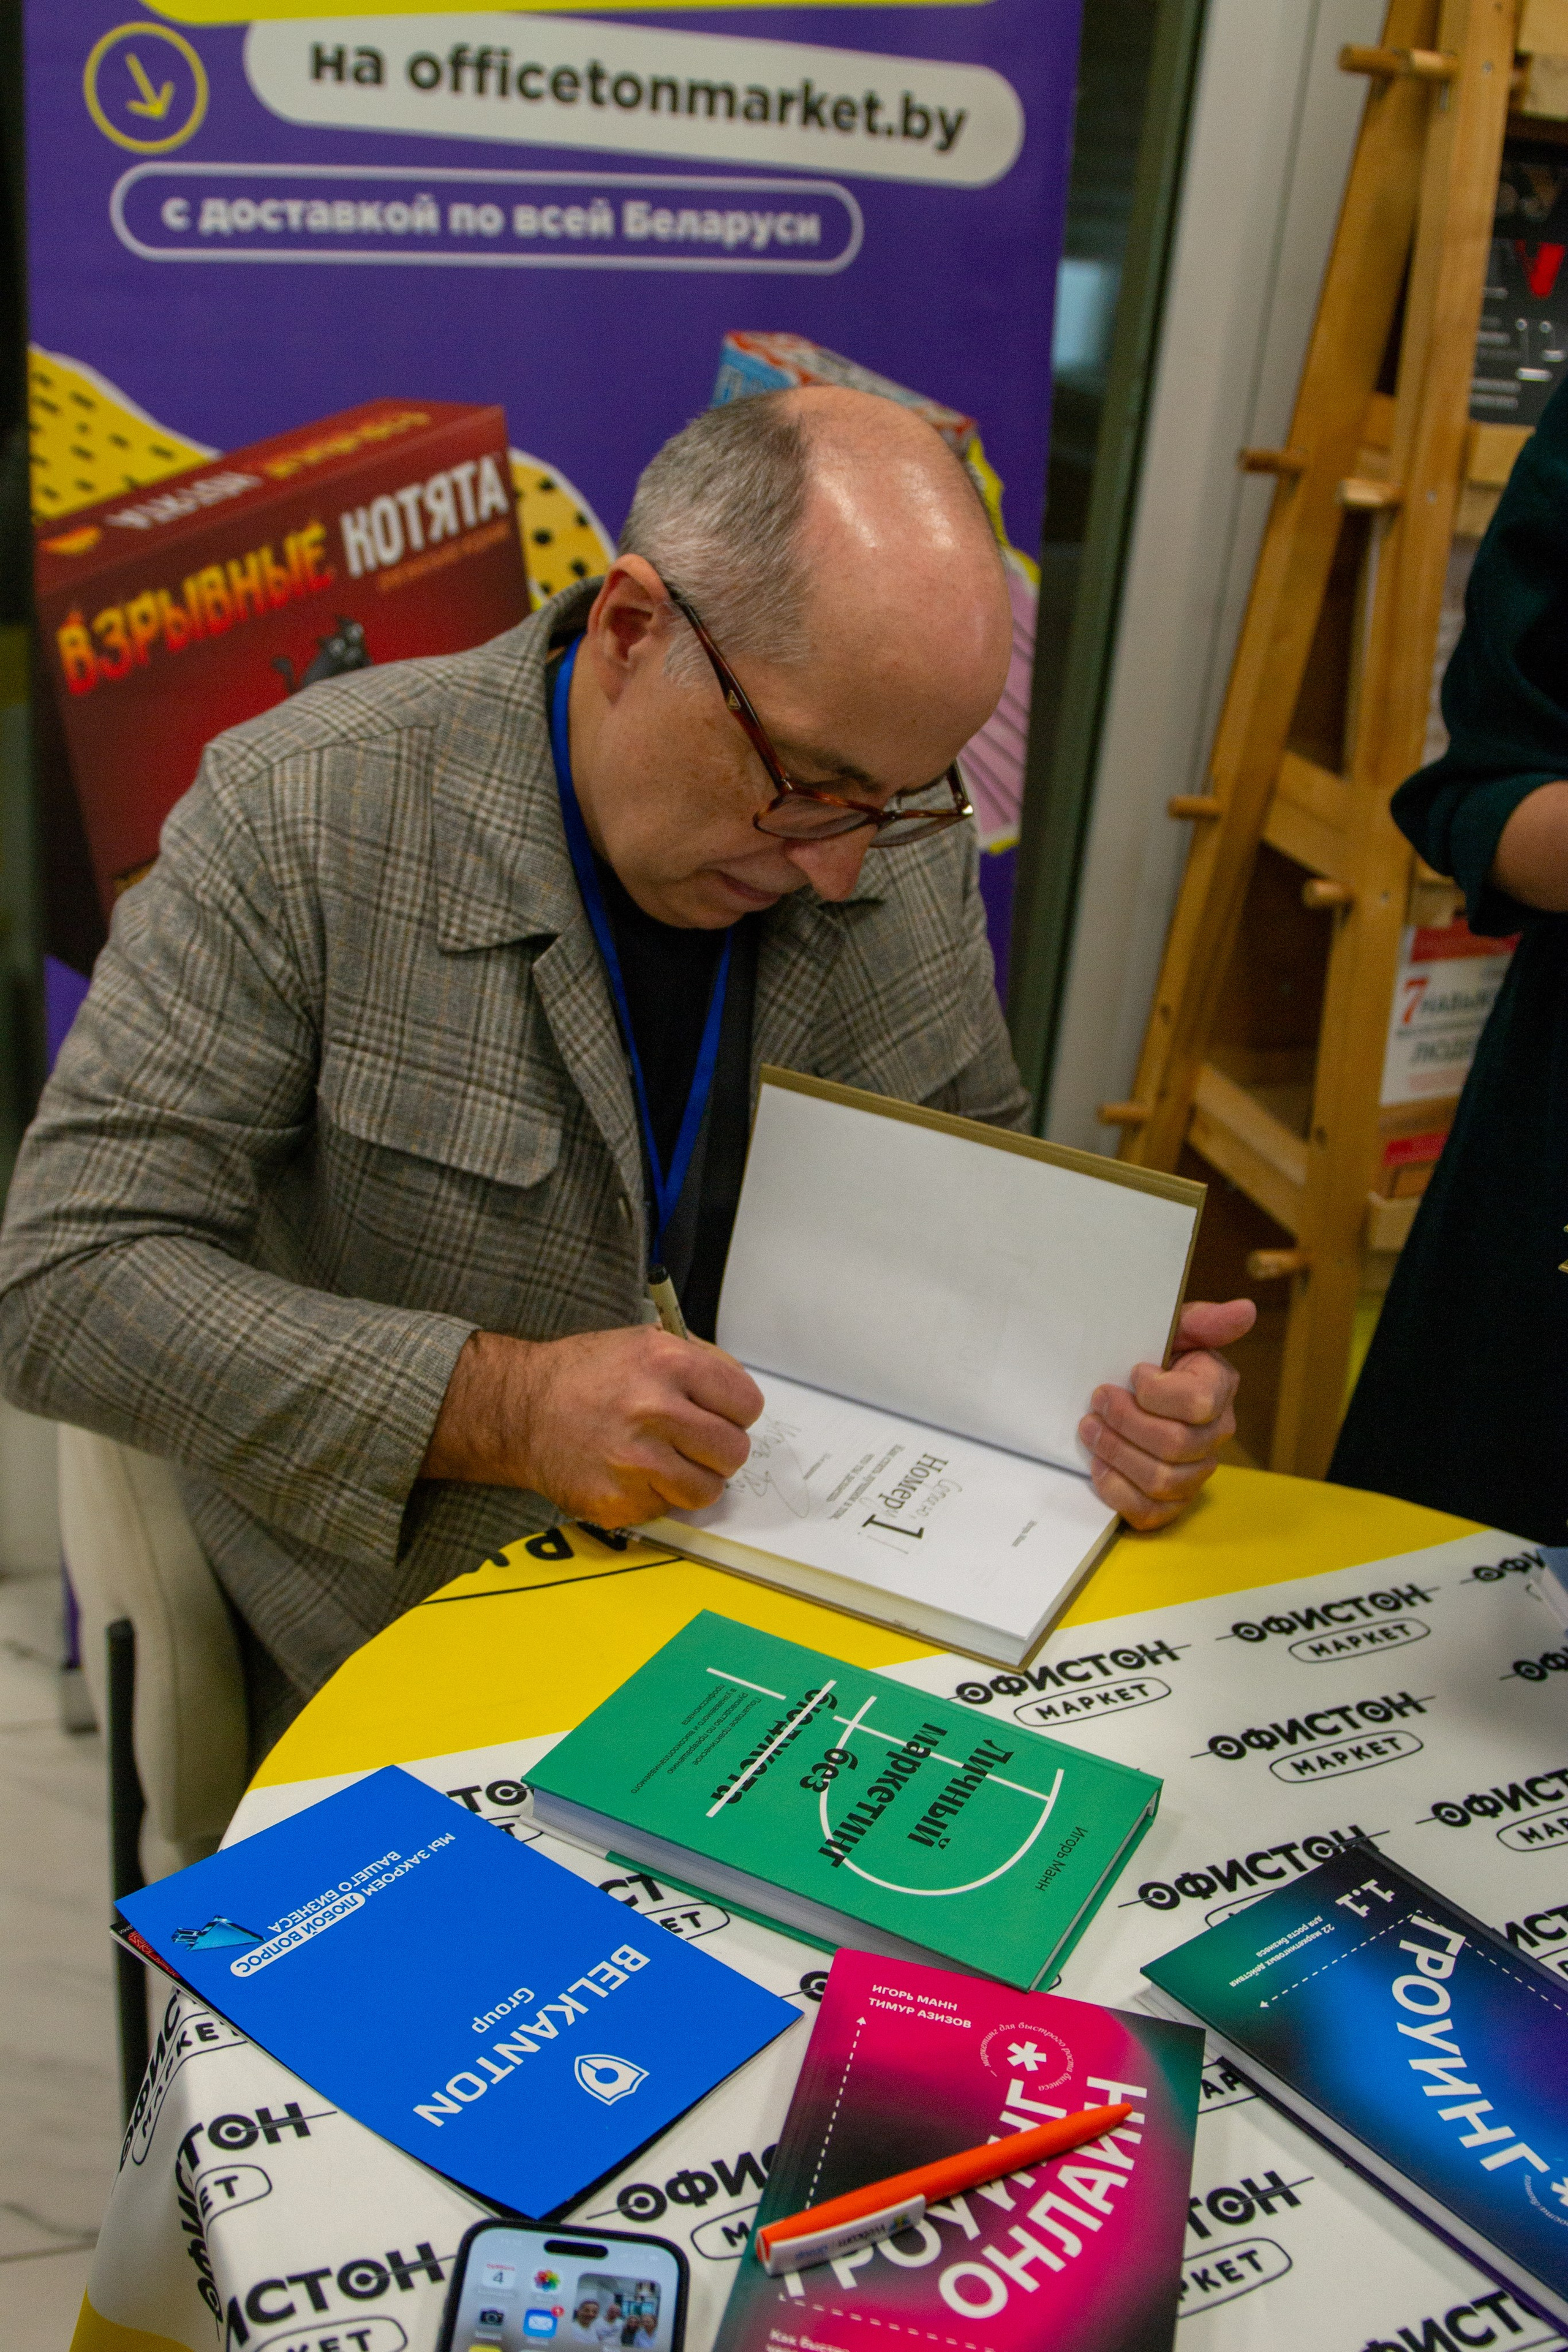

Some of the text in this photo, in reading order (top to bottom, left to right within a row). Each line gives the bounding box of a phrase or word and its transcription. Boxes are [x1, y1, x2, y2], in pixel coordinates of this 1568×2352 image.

[311, 42, 970, 152] на officetonmarket.by
[162, 195, 822, 250] с доставкой по всей Беларуси
[58, 519, 336, 696] ВЗРЫВНЫЕ
[340, 453, 511, 579] КОТЯТА
[1402, 976, 1430, 1025] 7
[862, 1453, 949, 1540] Номер 1
[1232, 1584, 1433, 1643] ОФИСТОН
[1308, 1624, 1412, 1657] МАРКЕТ
[956, 1640, 1181, 1705] ОФИСТОН
[1036, 1684, 1151, 1720] МАРКЕТ
[682, 1684, 725, 1725] профессионала
[692, 1697, 762, 1766] Пошаговое практическое
[697, 1692, 731, 1727] узнаваемого
[714, 1692, 748, 1727] руководство
[1208, 1692, 1427, 1760] ОФИСТОН
[631, 1730, 695, 1794] высокооплачиваемого
[667, 1734, 709, 1774] превращению
[710, 1689, 839, 1804] бюджета
[799, 1748, 859, 1793] без
[1291, 1737, 1404, 1776] МАРКЕТ
[818, 1723, 948, 1868] маркетинг
[907, 1739, 1015, 1850] Личный
[1035, 1826, 1088, 1892] Игорь Манн
[235, 1832, 456, 1973] МЫ ЗАКРОЕМ ЛЮБОЙ ВОПРОС
[267, 1850, 402, 1934] ВАШЕГО БИЗНЕСА
[1335, 1879, 1395, 1917] 1.1
[1229, 1924, 1335, 1988] 22 маркетинговых действия
[1256, 1915, 1323, 1958] для роста бизнеса
[472, 1987, 535, 2034] Group
[869, 1997, 972, 2029] ТИМУР АЗИЗОВ
[872, 1984, 958, 2011] ИГОРЬ МАНН
[413, 1943, 651, 2127] BELKANTON
[980, 2022, 1075, 2091] маркетинг для быстрого роста бизнеса
[1392, 1915, 1550, 2172] ГРОУИНГ
[492, 2271, 503, 2284] 4
